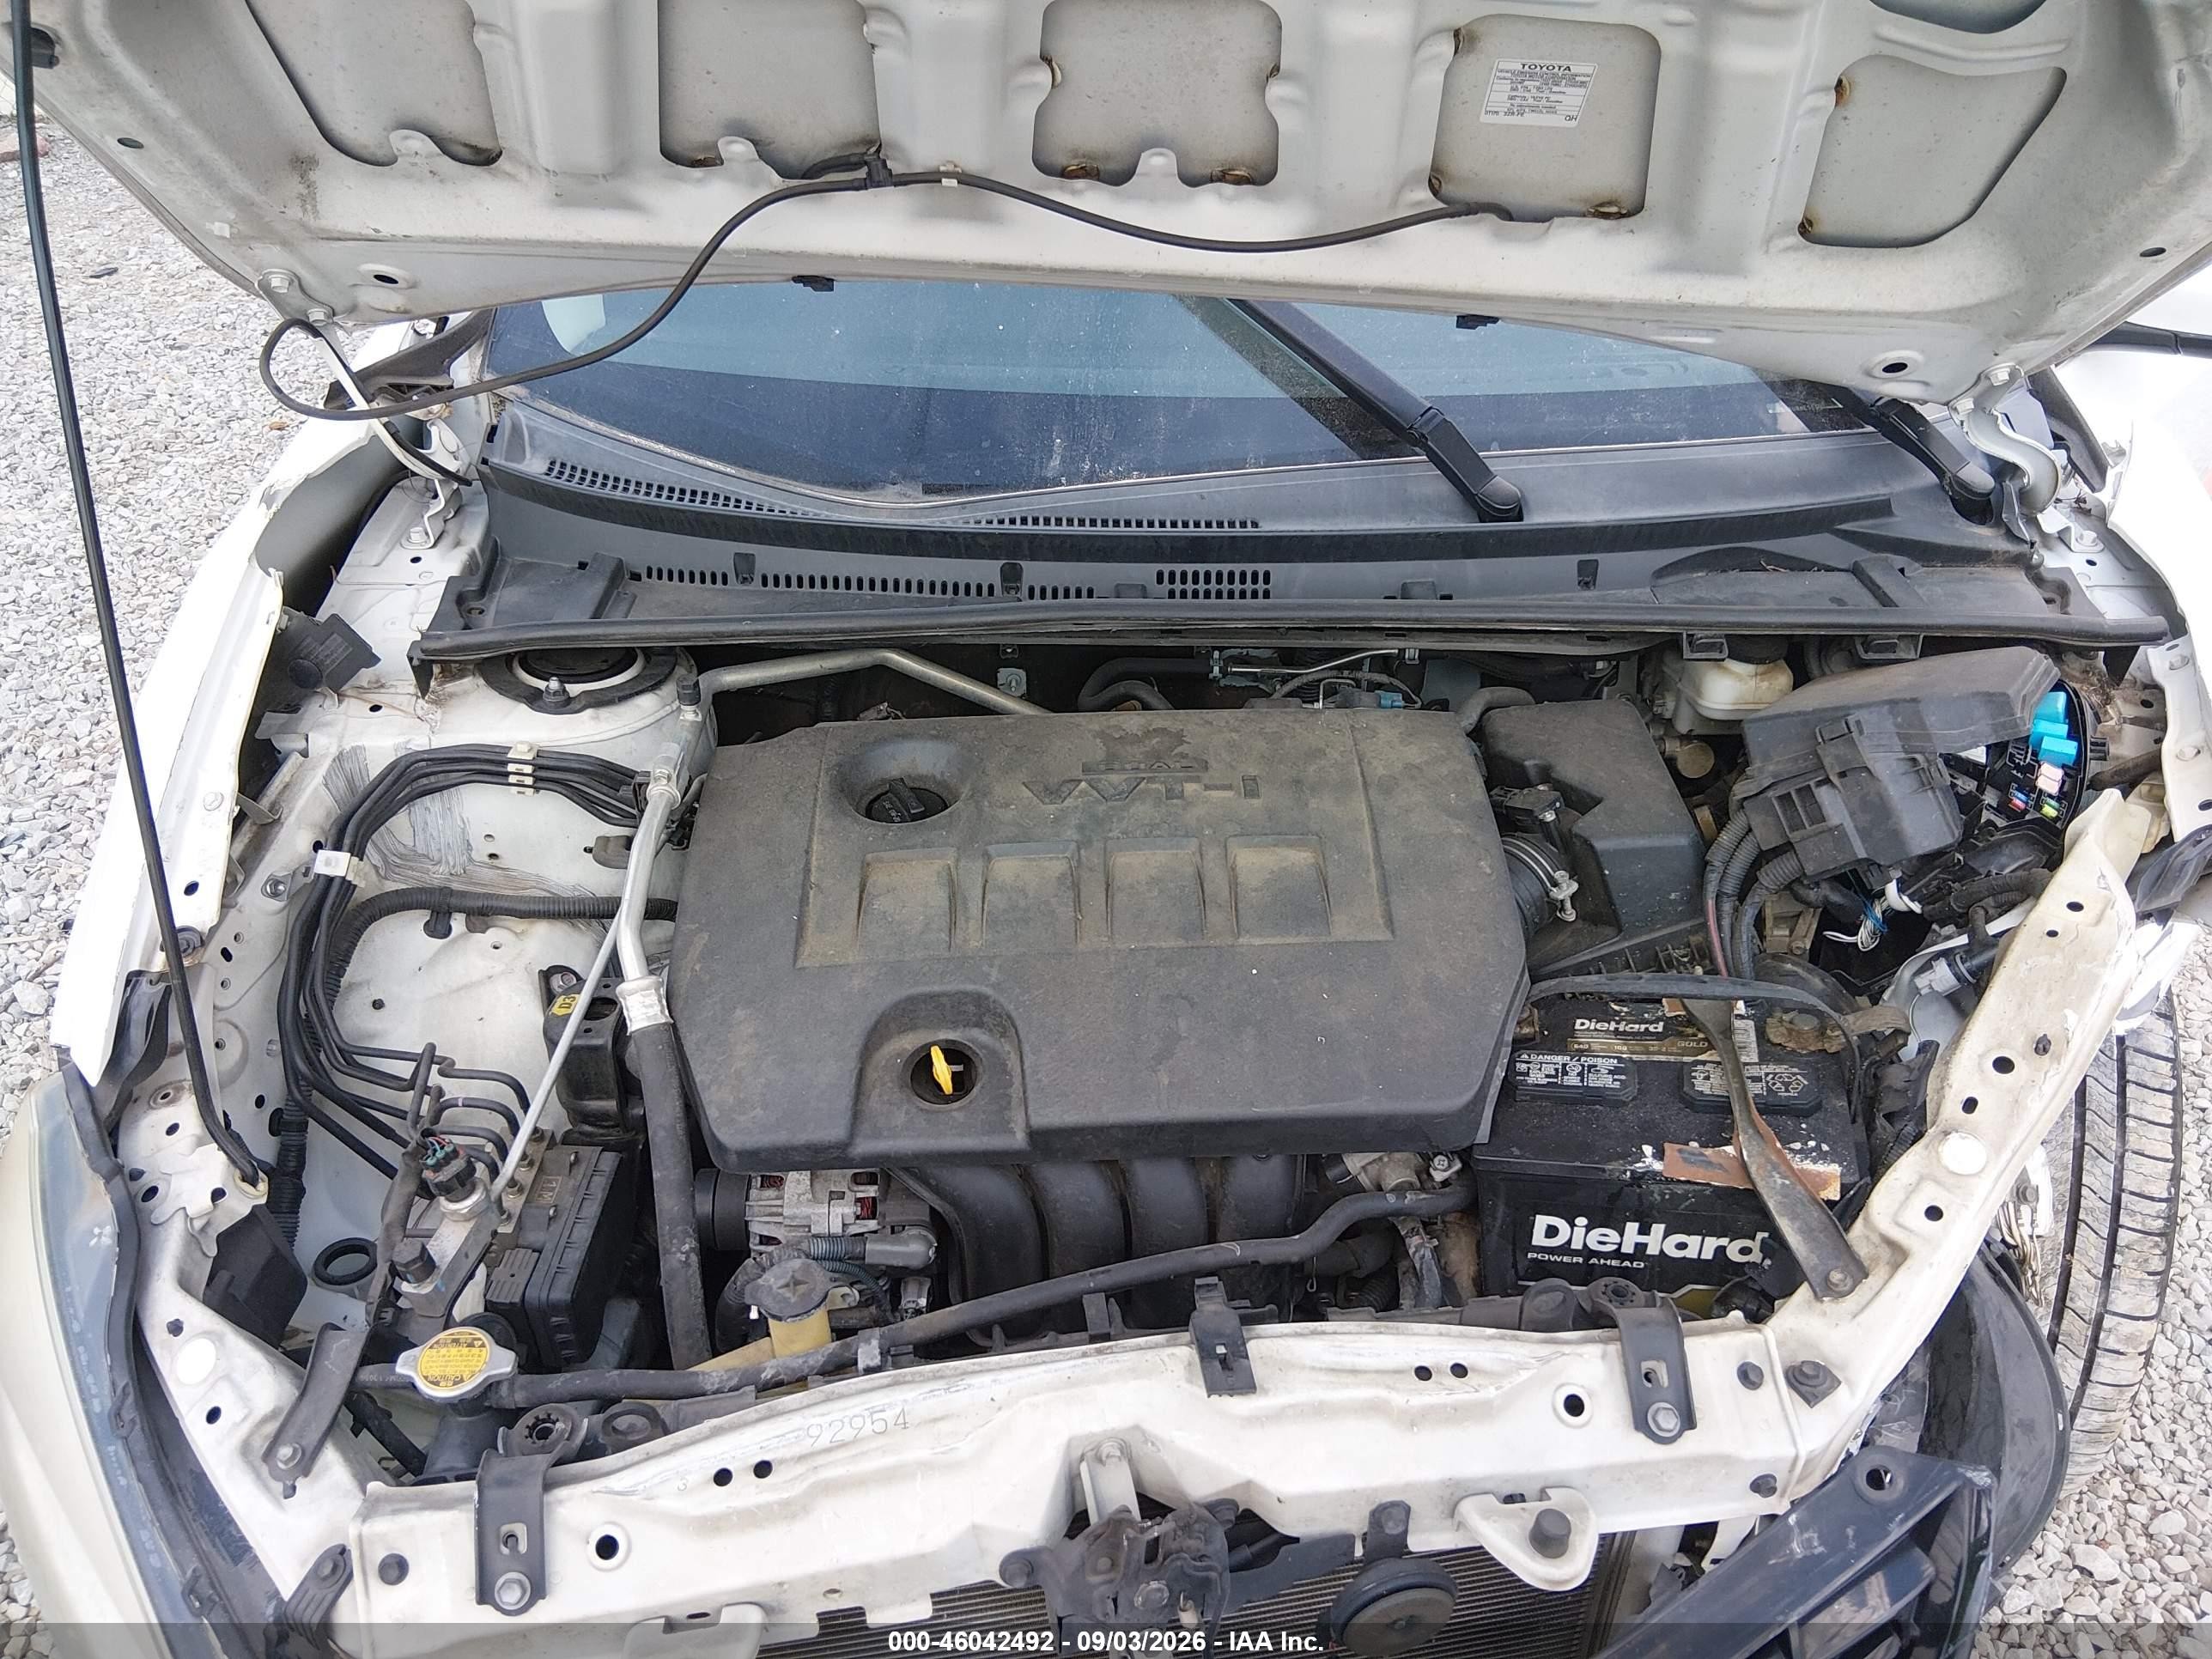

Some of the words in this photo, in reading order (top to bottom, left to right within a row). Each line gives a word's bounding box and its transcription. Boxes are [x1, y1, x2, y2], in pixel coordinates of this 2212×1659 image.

[1521, 64, 1571, 72] TOYOTA
[557, 996, 576, 1009] D3
[1574, 1018, 1664, 1033] DieHard
[1531, 1214, 1770, 1264] DieHard
[1527, 1252, 1583, 1265] POWER
[1588, 1256, 1645, 1269] AHEAD
[805, 1408, 909, 1448] 92954
